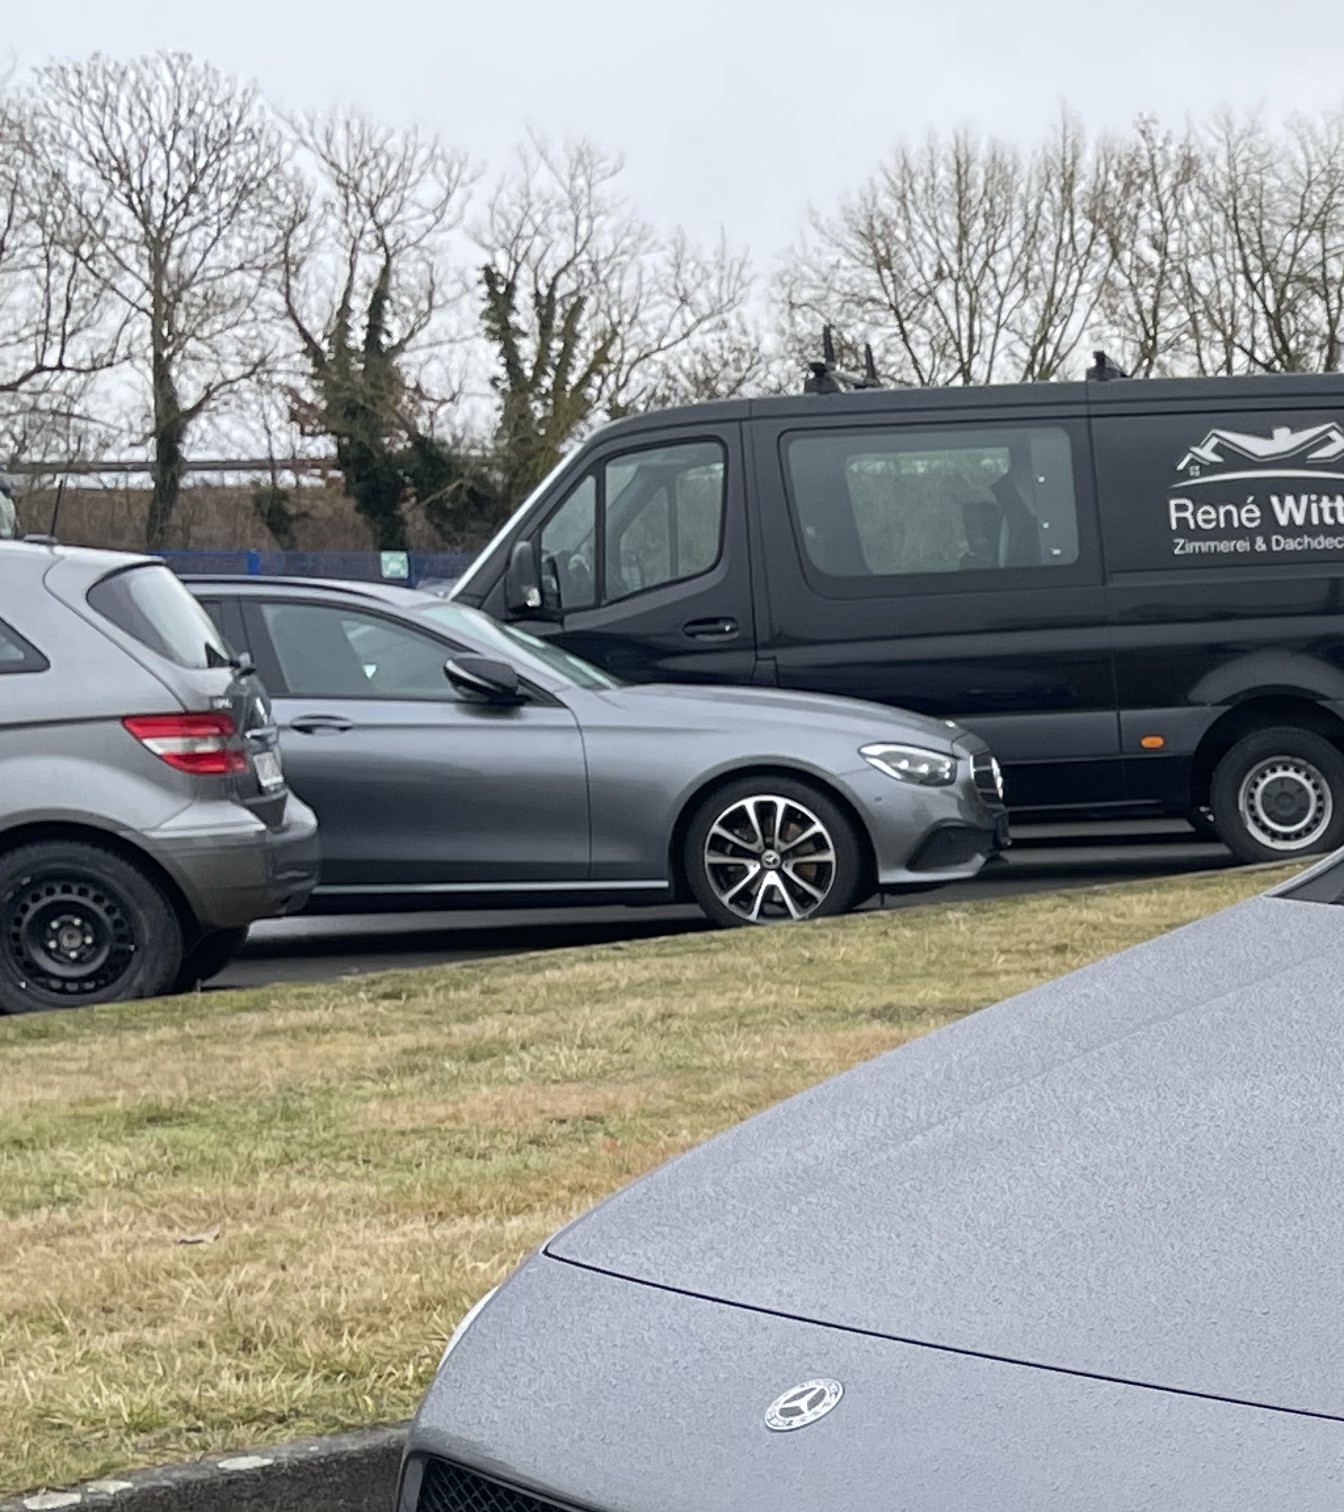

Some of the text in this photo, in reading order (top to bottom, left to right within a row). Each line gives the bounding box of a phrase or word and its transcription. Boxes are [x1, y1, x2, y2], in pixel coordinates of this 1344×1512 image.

[1168, 496, 1262, 531] René
[1173, 534, 1251, 556] Zimmerei
[1254, 535, 1268, 552] &
